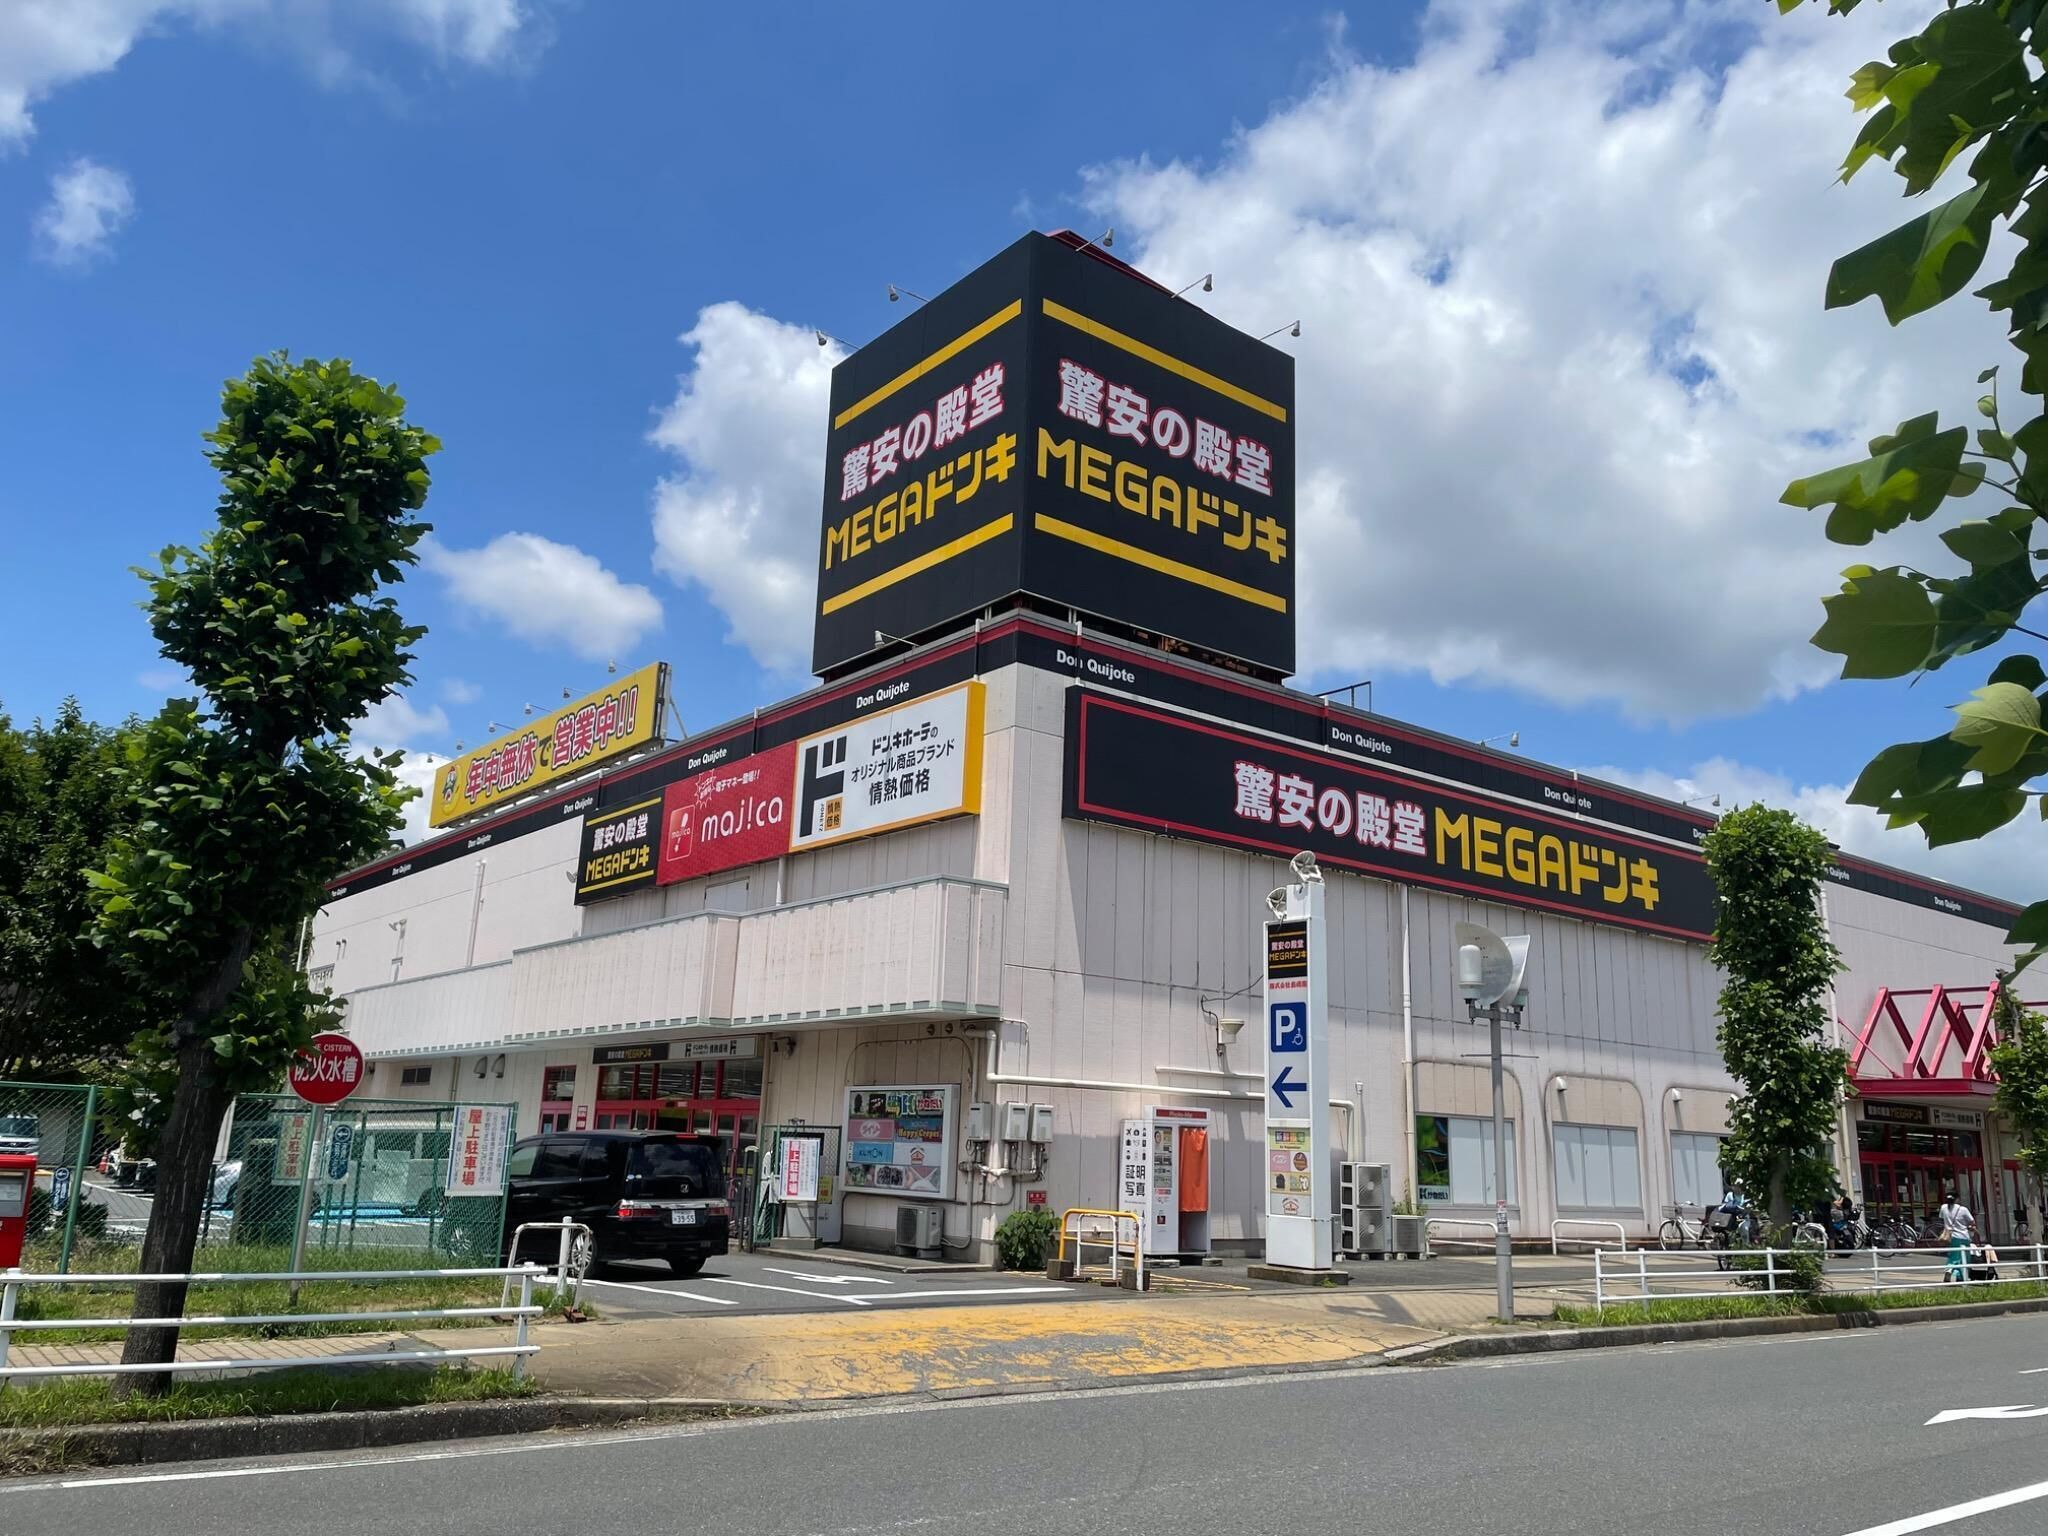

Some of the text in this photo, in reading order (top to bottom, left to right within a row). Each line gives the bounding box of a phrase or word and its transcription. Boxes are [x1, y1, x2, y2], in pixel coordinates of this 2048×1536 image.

[840, 362, 1006, 501] 驚安の殿堂
[1058, 358, 1272, 496] 驚安の殿堂
[825, 432, 1017, 570] MEGAドンキ
[1036, 426, 1287, 564] MEGAドンキ
[1087, 658, 1135, 683] Quijote
[856, 681, 910, 709] Don Quijote
[688, 747, 728, 770] Don Quijote
[1331, 726, 1392, 755] Don Quijote
[851, 738, 955, 783] オリジナル商品ブランド
[869, 768, 930, 806] 情熱価格
[1544, 786, 1592, 809] Don Quiote
[1233, 760, 1427, 857] 驚安の殿堂
[592, 813, 649, 852] 驚安の殿堂
[585, 844, 650, 882] MEGAドンキ
[1434, 807, 1660, 910] MEGAドンキ
[1275, 1009, 1296, 1046] P
[323, 1043, 353, 1052] CISTERN
[462, 1109, 482, 1186] 屋上駐車場
[1125, 1165, 1146, 1180] 証明
[1125, 1181, 1146, 1197] 写真
